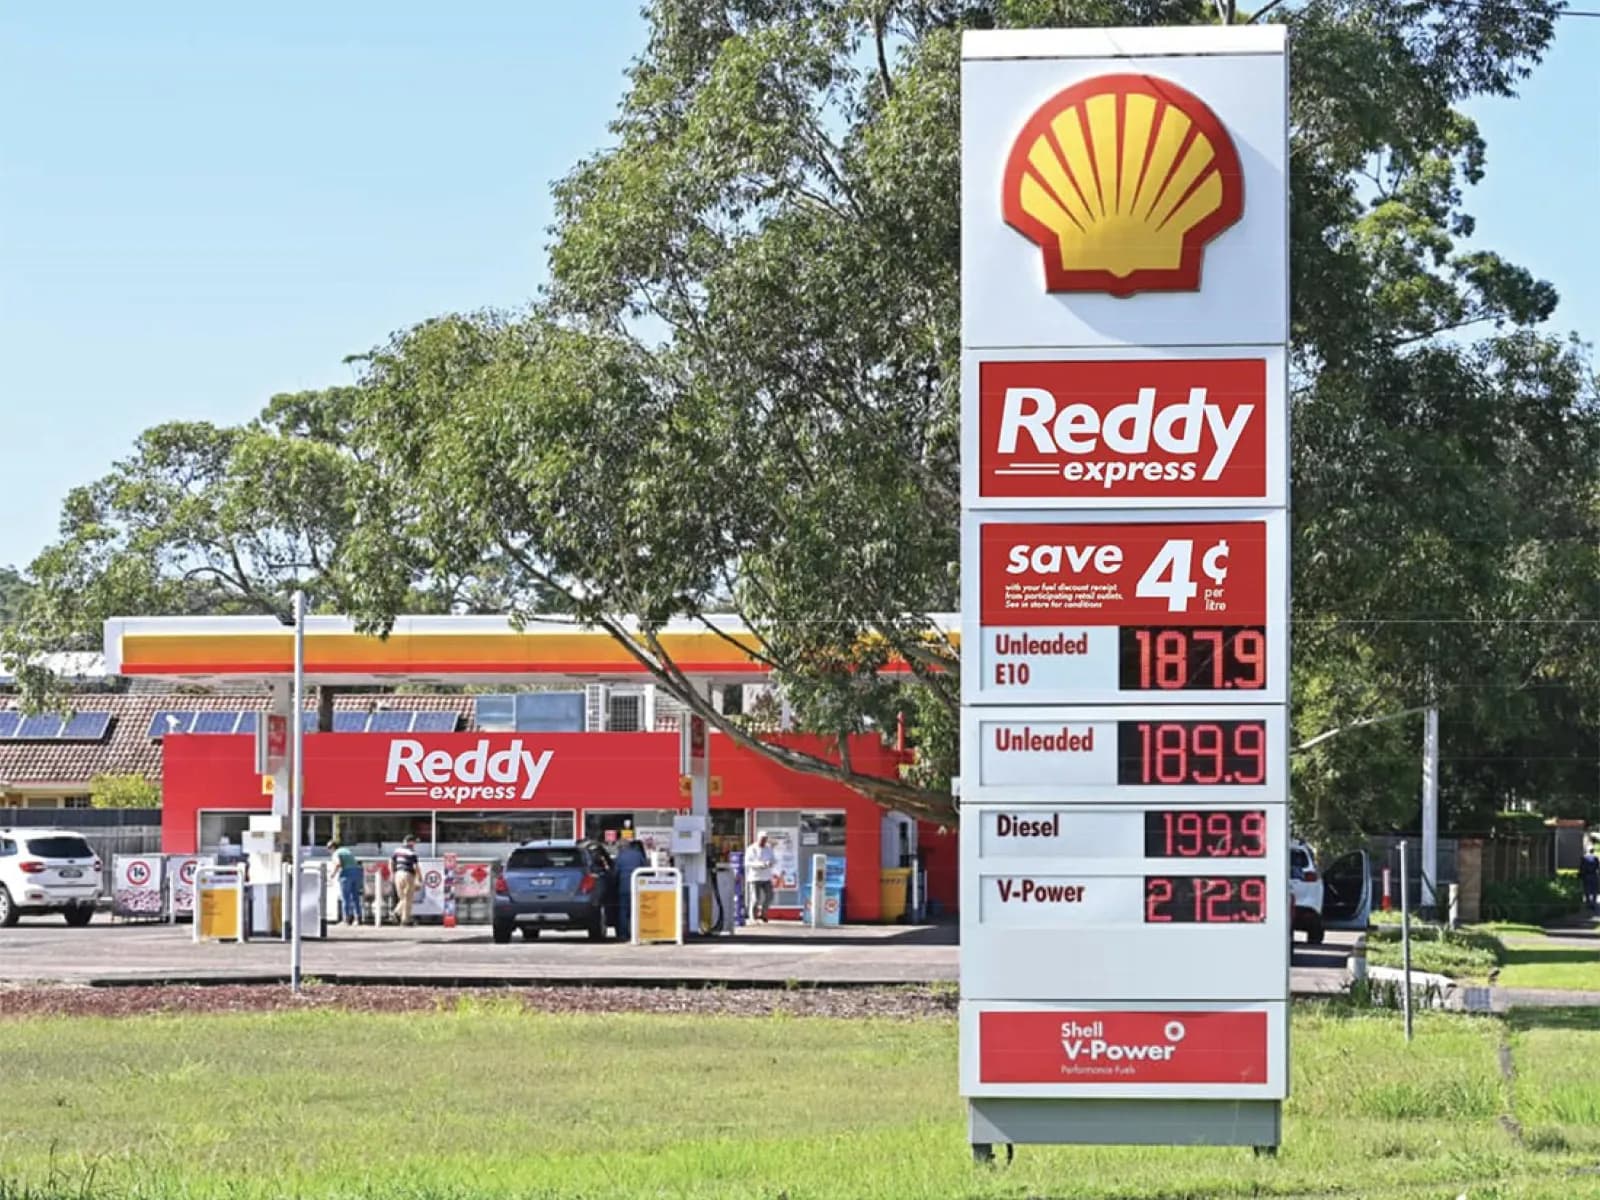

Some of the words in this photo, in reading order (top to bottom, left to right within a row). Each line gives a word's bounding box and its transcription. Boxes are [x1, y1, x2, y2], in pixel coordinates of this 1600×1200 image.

[997, 387, 1255, 481] Reddy
[1063, 461, 1197, 488] express
[1005, 544, 1124, 574] save
[1005, 582, 1021, 591] with
[1022, 584, 1040, 594] your
[1041, 582, 1056, 591] fuel
[1058, 582, 1089, 591] discount
[1090, 583, 1118, 593] receipt
[1005, 591, 1023, 600] from
[1024, 591, 1073, 602] participating
[1074, 591, 1095, 600] retail
[1204, 588, 1225, 601] per
[1005, 600, 1020, 608] See
[1029, 600, 1050, 608] store
[1050, 600, 1063, 608] for
[1064, 600, 1102, 608] conditions
[1205, 599, 1227, 611] litre
[995, 632, 1088, 655] Unleaded
[1135, 630, 1265, 689] 187.9
[995, 663, 1030, 685] E10
[995, 727, 1094, 752] Unleaded
[1137, 724, 1266, 783] 189.9
[385, 739, 555, 800] Reddy
[429, 786, 517, 805] express
[996, 813, 1060, 837] Diesel
[1163, 813, 1266, 857] 199.9
[997, 879, 1085, 903] V-Power
[1060, 1020, 1104, 1039] Shell
[1061, 1039, 1177, 1061] V-Power
[1060, 1064, 1113, 1075] Performance
[1114, 1064, 1136, 1075] Fuels
